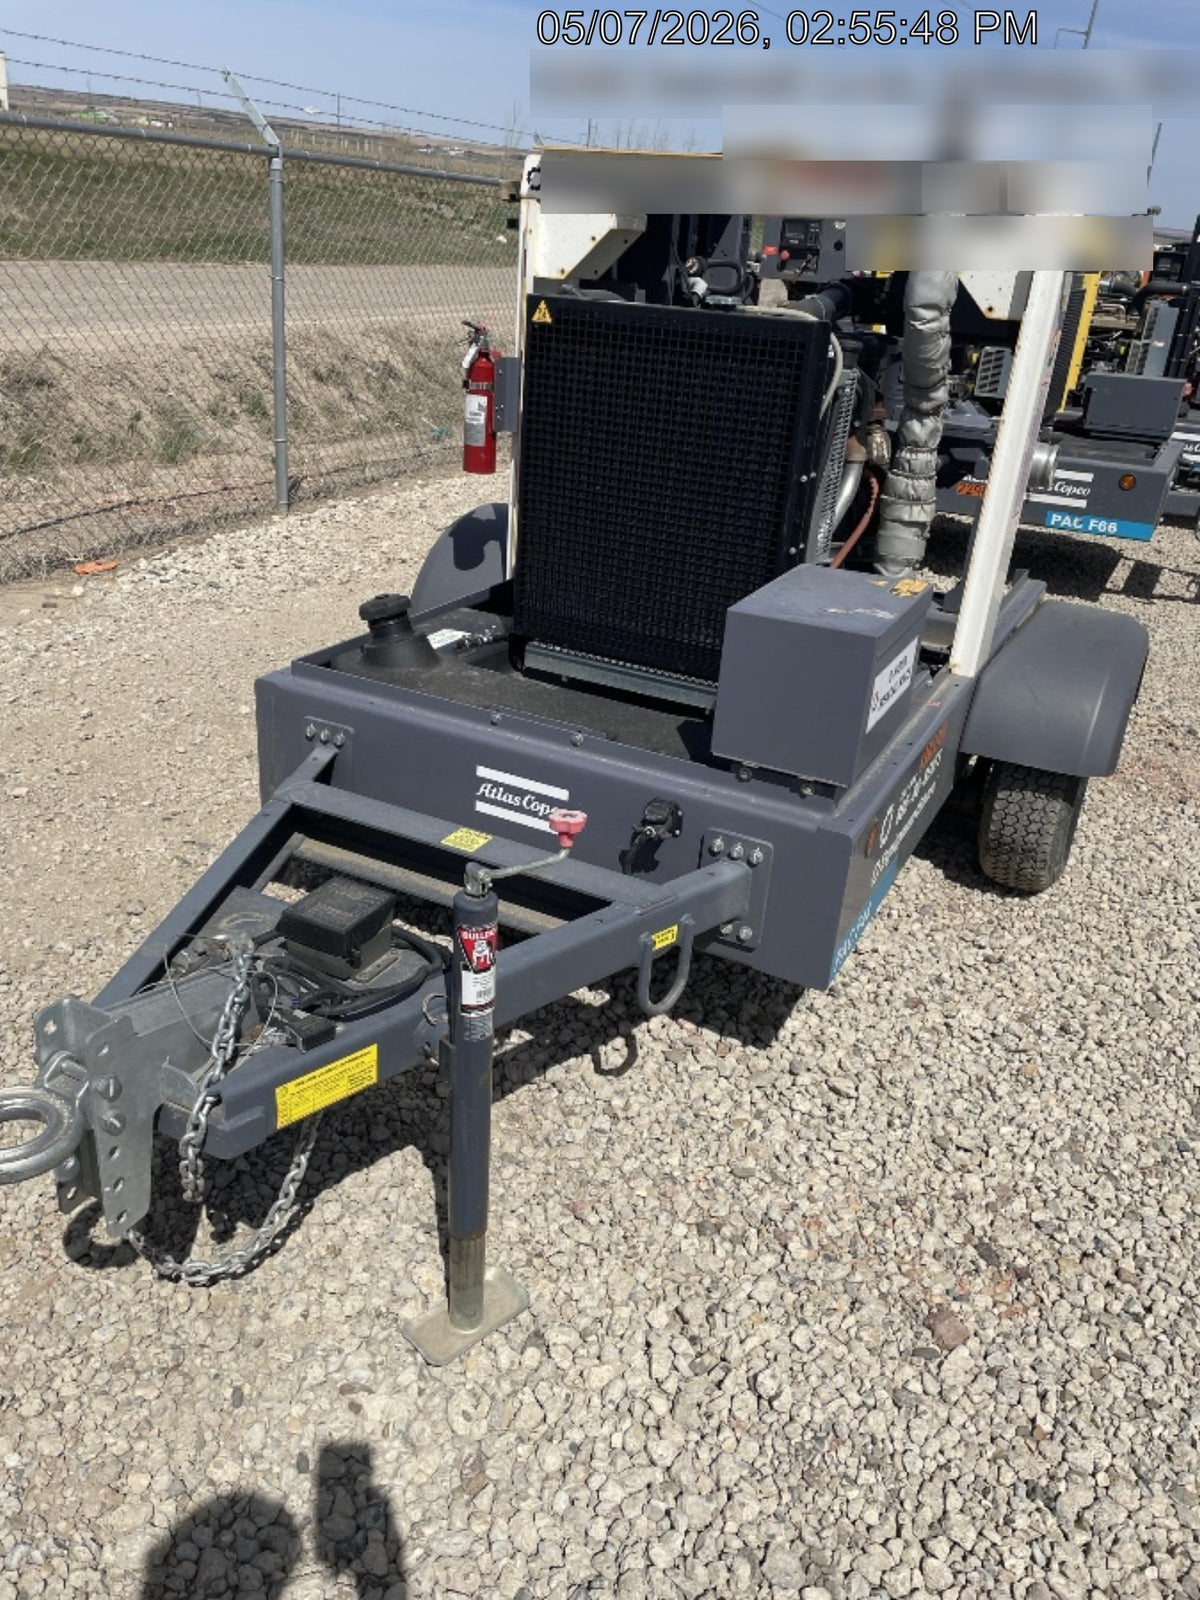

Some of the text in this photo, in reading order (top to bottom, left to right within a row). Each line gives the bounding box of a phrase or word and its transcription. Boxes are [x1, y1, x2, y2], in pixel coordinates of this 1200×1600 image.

[1053, 481, 1091, 497] Copco
[1050, 512, 1118, 534] PAC F66
[476, 782, 522, 806] Atlas
